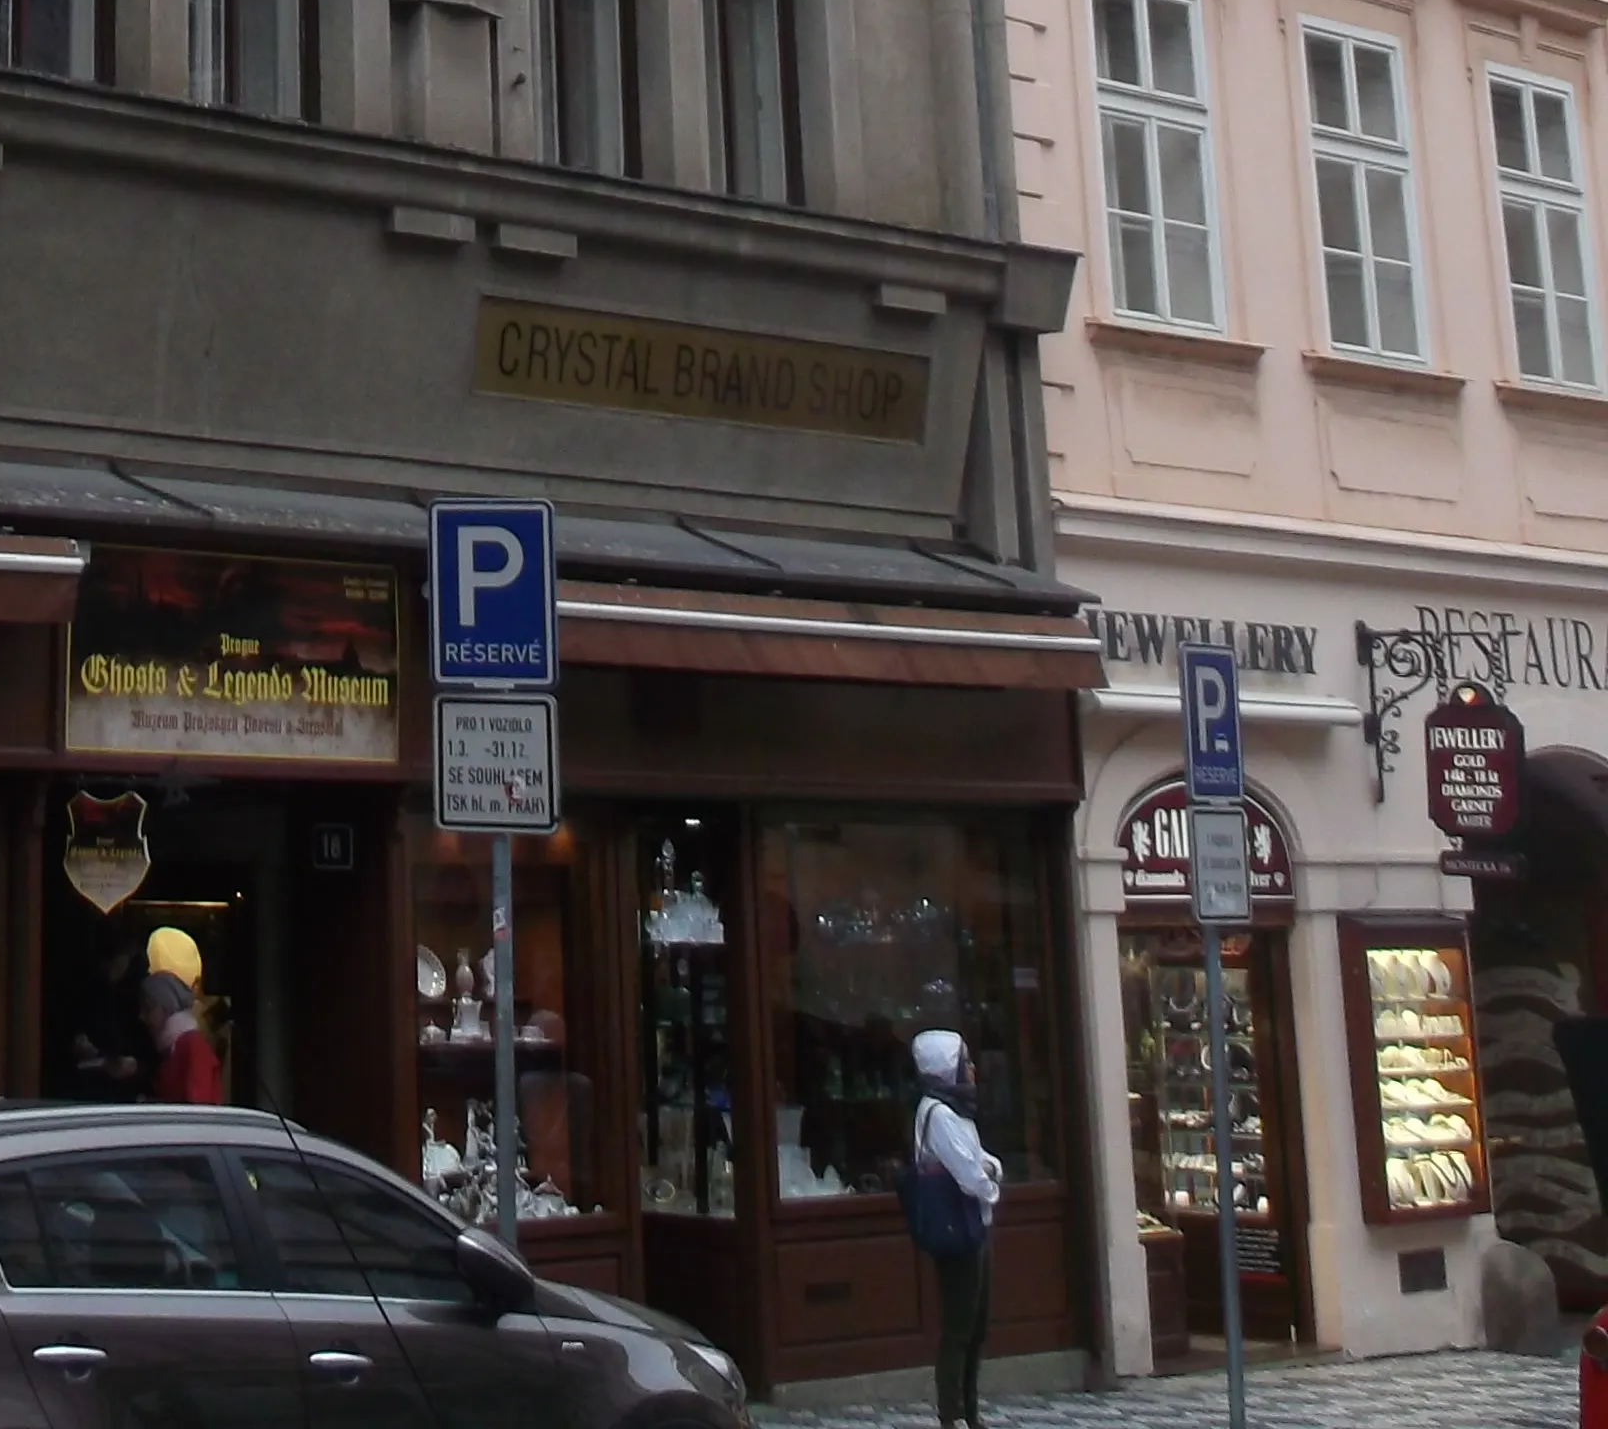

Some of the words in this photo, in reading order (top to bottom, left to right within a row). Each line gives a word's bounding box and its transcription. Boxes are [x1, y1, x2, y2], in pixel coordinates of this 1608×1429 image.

[498, 321, 661, 396] CRYSTAL
[673, 344, 797, 411] BRAND
[809, 362, 904, 421] SHOP
[457, 525, 525, 627] P
[220, 632, 260, 657] Prague
[445, 639, 542, 664] RÉSERVÉ
[1414, 604, 1608, 691] RESTAUR
[81, 653, 168, 696] Ghosts
[176, 664, 198, 698] &
[203, 659, 293, 706] Legends
[301, 664, 390, 707] Museum
[1195, 665, 1227, 754] P
[455, 715, 478, 732] PRO
[479, 716, 486, 732] 1
[488, 716, 533, 734] VOZIDLO
[1430, 726, 1507, 750] JEWELLERY
[1453, 753, 1487, 768] GOLD
[448, 765, 465, 785] SE
[1442, 783, 1503, 799] DIAMONDS
[446, 792, 469, 813] TSK
[1451, 798, 1494, 813] GARNET
[1456, 814, 1492, 827] AMBER
[1249, 870, 1272, 887] lver
